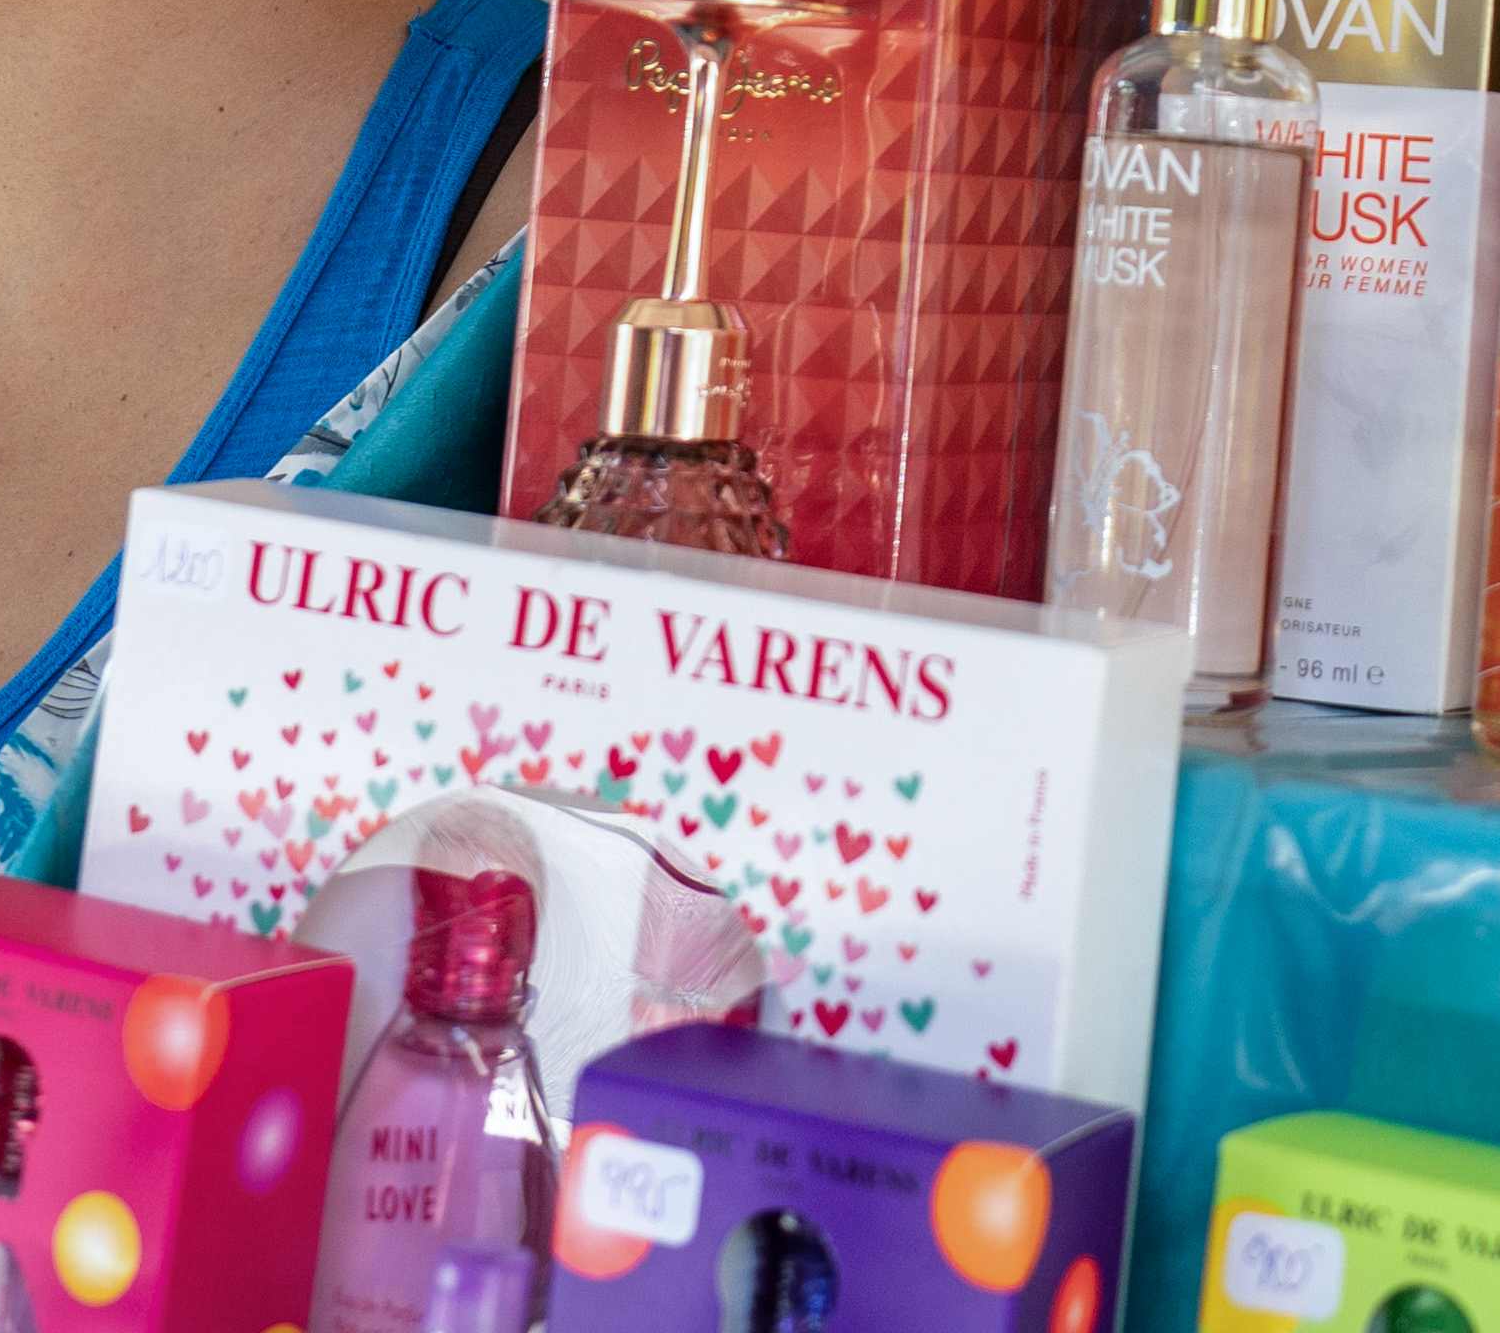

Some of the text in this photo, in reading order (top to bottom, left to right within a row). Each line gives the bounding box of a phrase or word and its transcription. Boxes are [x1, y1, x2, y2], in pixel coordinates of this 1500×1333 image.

[1316, 129, 1434, 184] HITE
[1311, 189, 1431, 248] USK
[1085, 245, 1168, 287] USK
[1340, 254, 1429, 277] WOMEN
[1343, 275, 1428, 297] FEMME
[247, 539, 957, 726] ULRIC DE VARENS
[1281, 619, 1362, 637] ORISATEUR
[541, 671, 612, 702] PARIS
[1296, 658, 1324, 679] 96
[1331, 663, 1358, 684] ml
[365, 1184, 438, 1222] LOVE
